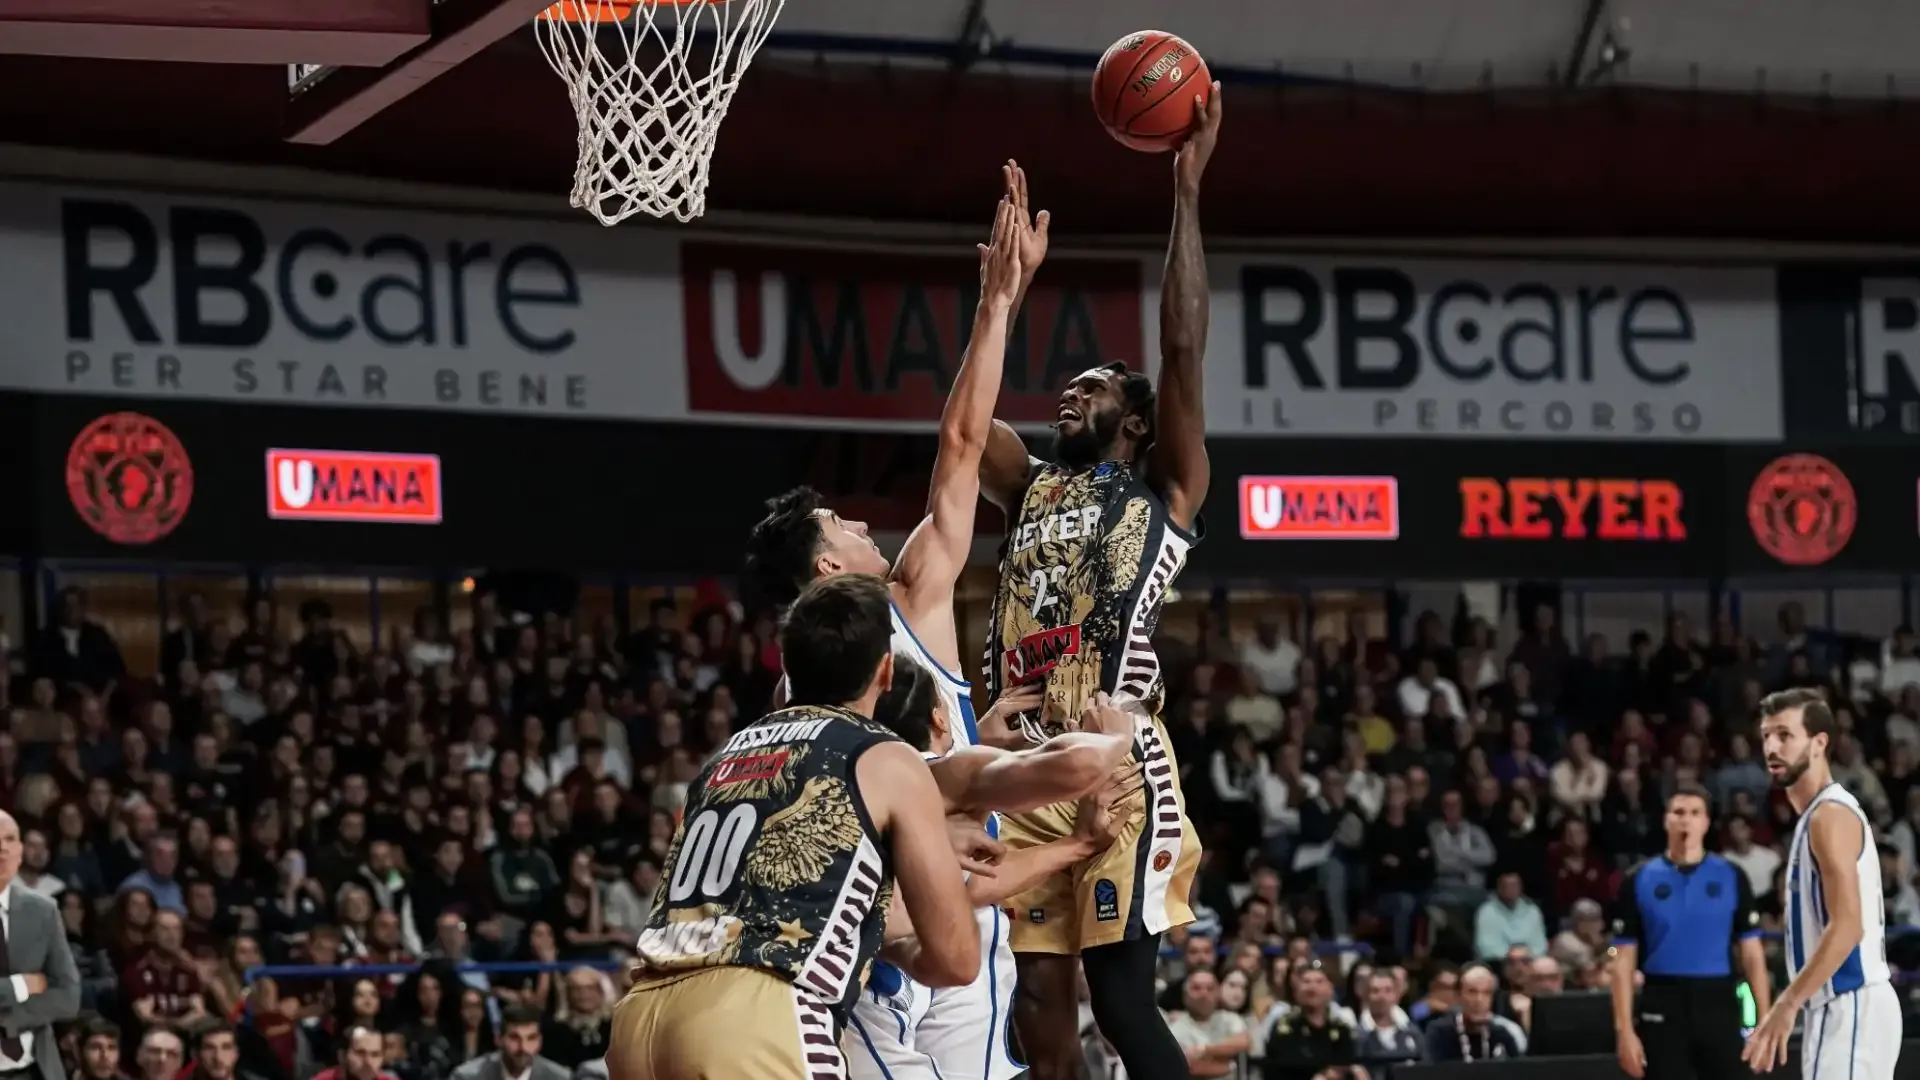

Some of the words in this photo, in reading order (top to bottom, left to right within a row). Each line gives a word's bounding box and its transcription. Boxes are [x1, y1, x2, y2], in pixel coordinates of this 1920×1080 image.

[1132, 43, 1189, 97] PALDING
[61, 198, 581, 355] RBcare
[1241, 264, 1696, 387] RBcare
[66, 350, 182, 389] PER
[232, 357, 388, 397] STAR
[434, 368, 588, 407] BENE
[1243, 398, 1292, 429] IL
[1373, 398, 1702, 433] PERCORSO
[278, 459, 425, 508] UMANA
[1251, 485, 1382, 529] UMANA
[1459, 477, 1687, 539] REYER
[669, 803, 757, 901] 00
